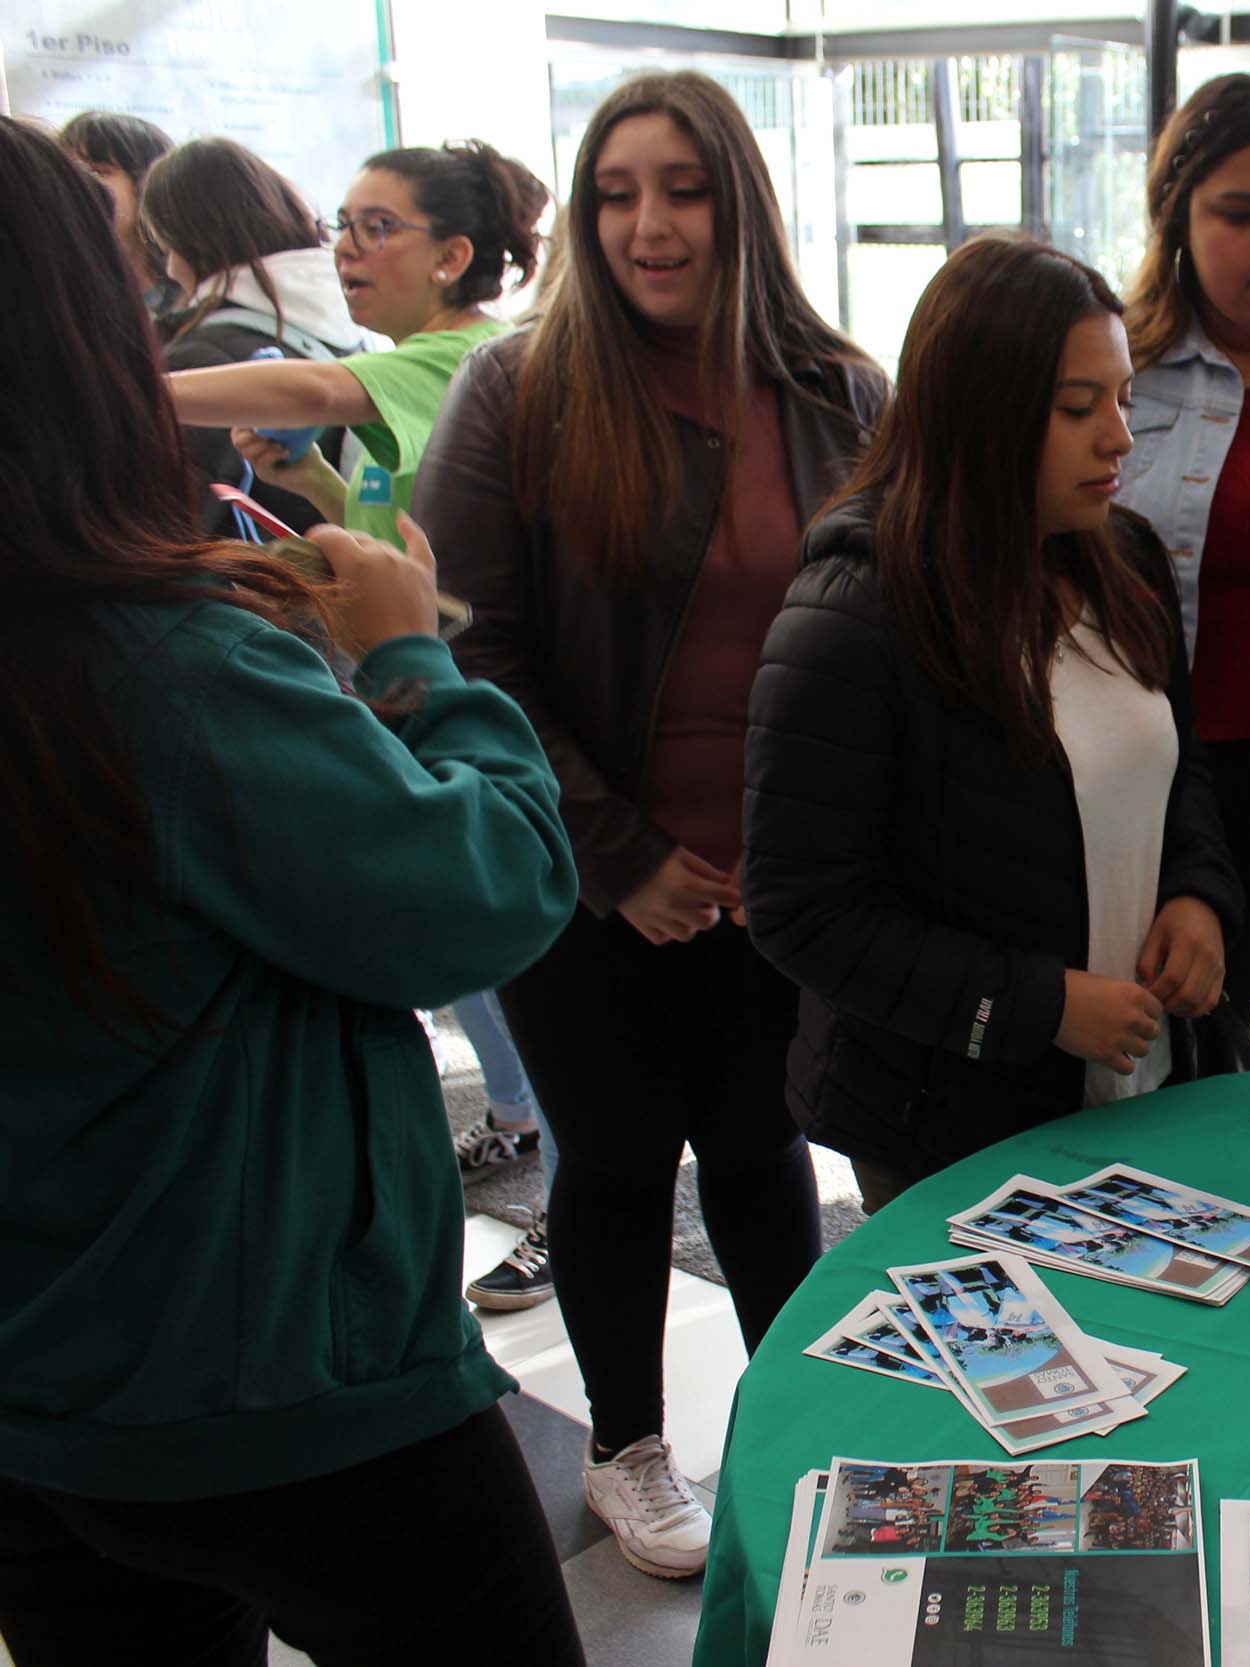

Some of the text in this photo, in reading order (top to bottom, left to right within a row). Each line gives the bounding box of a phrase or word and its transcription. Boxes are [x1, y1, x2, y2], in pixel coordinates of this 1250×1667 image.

[25, 29, 131, 56] 1er Piso
[810, 1617, 833, 1649] DAE
